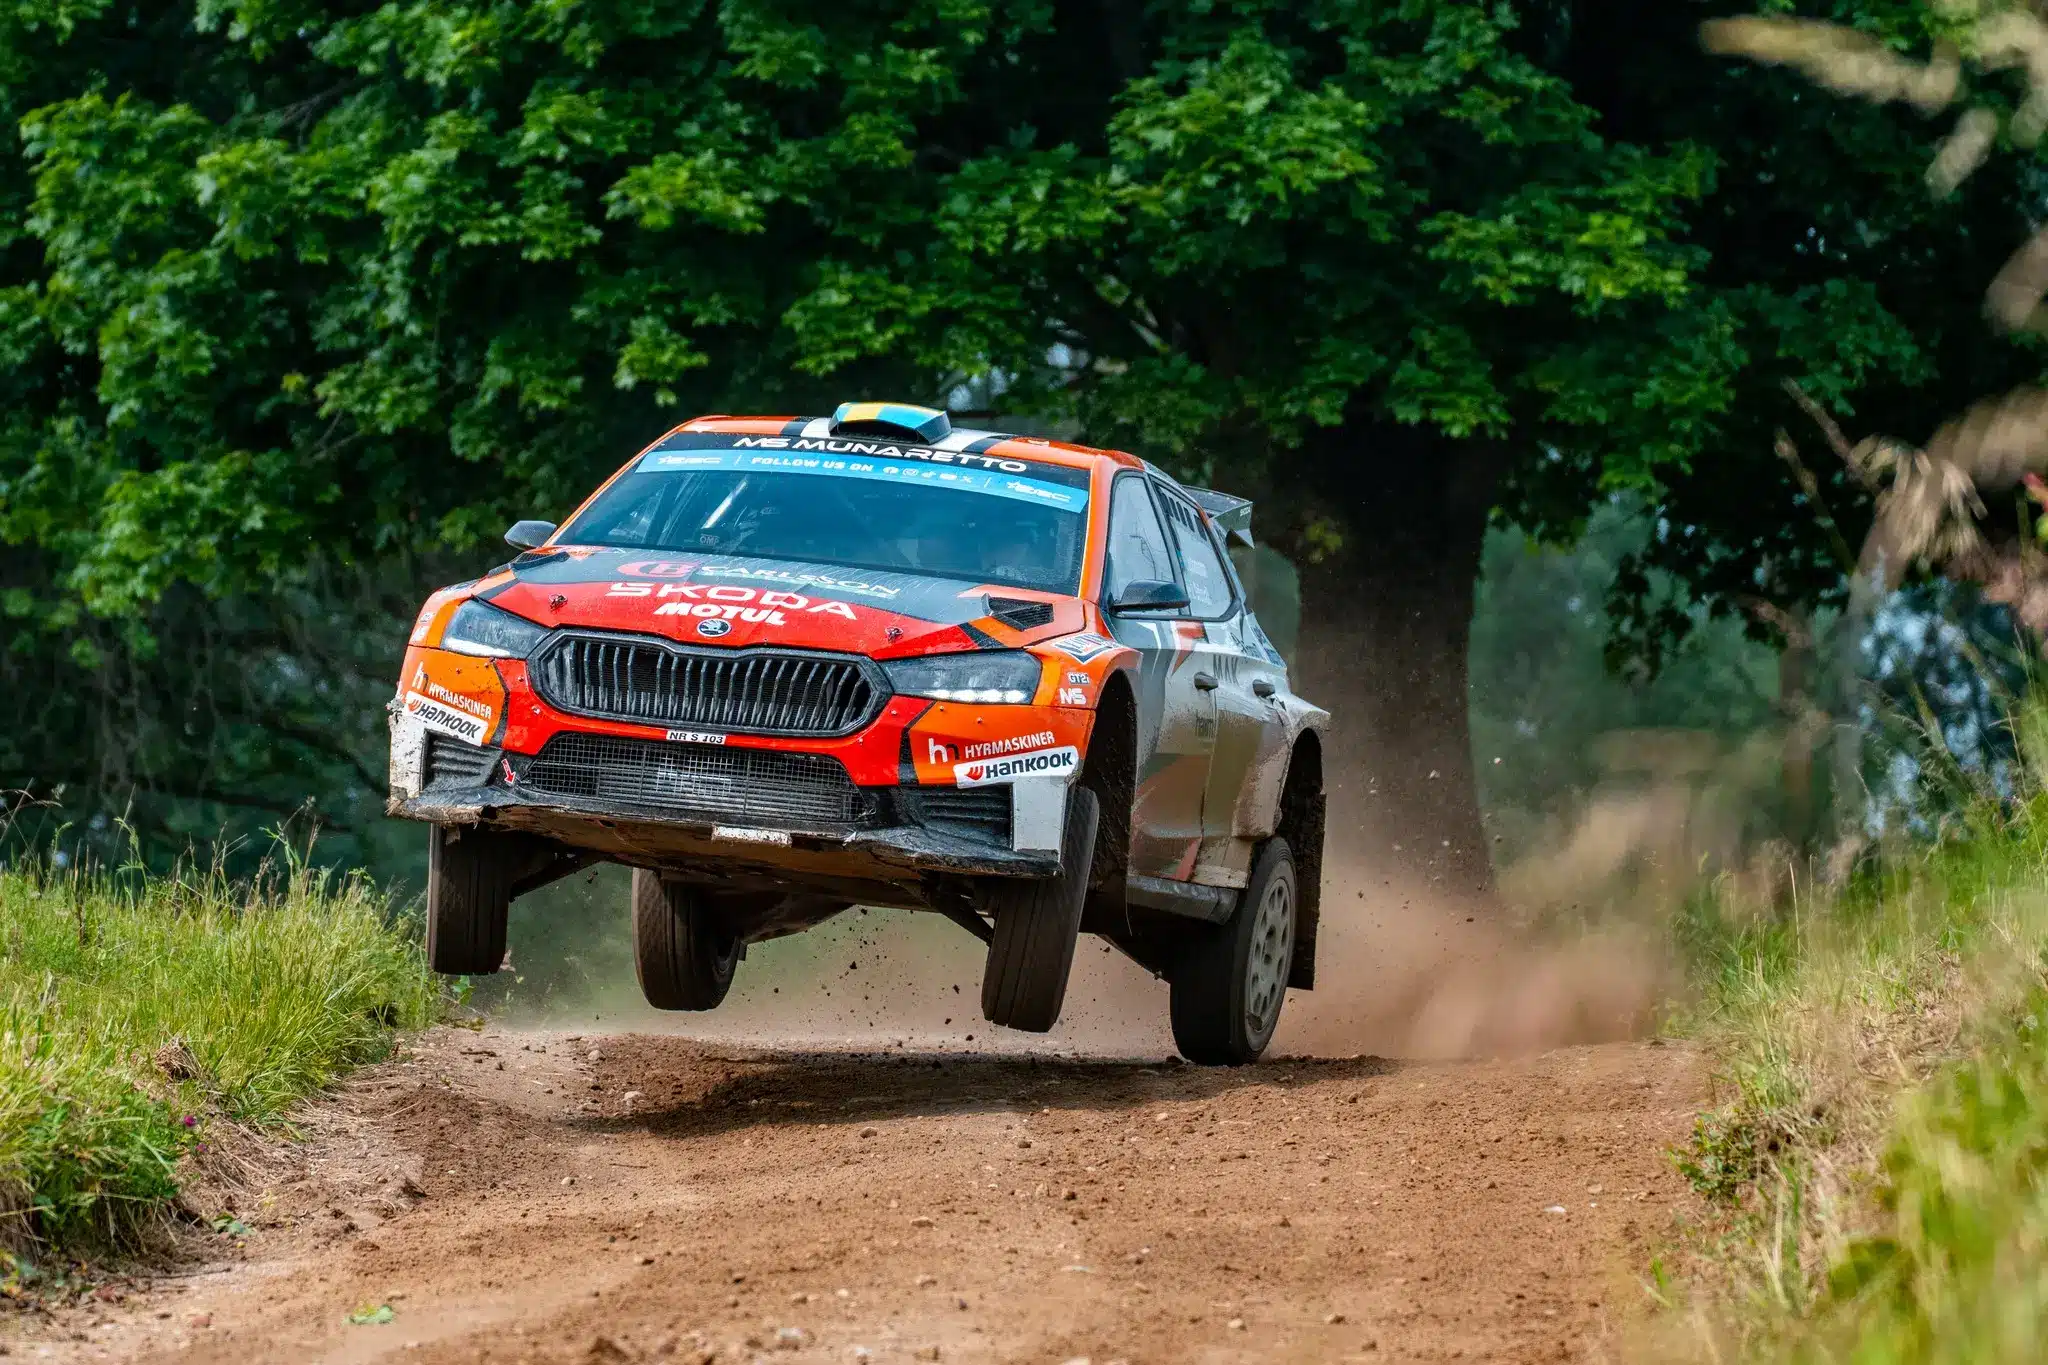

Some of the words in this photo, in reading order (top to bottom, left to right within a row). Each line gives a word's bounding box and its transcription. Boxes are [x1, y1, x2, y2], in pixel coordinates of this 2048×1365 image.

[751, 457, 820, 468] FOLLOW
[823, 460, 845, 470] US
[850, 463, 873, 472] ON
[793, 439, 1027, 472] MUNARETTO
[701, 566, 901, 596] CARLSSON
[653, 602, 787, 626] MOTUL
[428, 682, 493, 720] HYRMASKINER
[702, 735, 724, 744] 103
[964, 731, 1056, 759] HYRMASKINER
